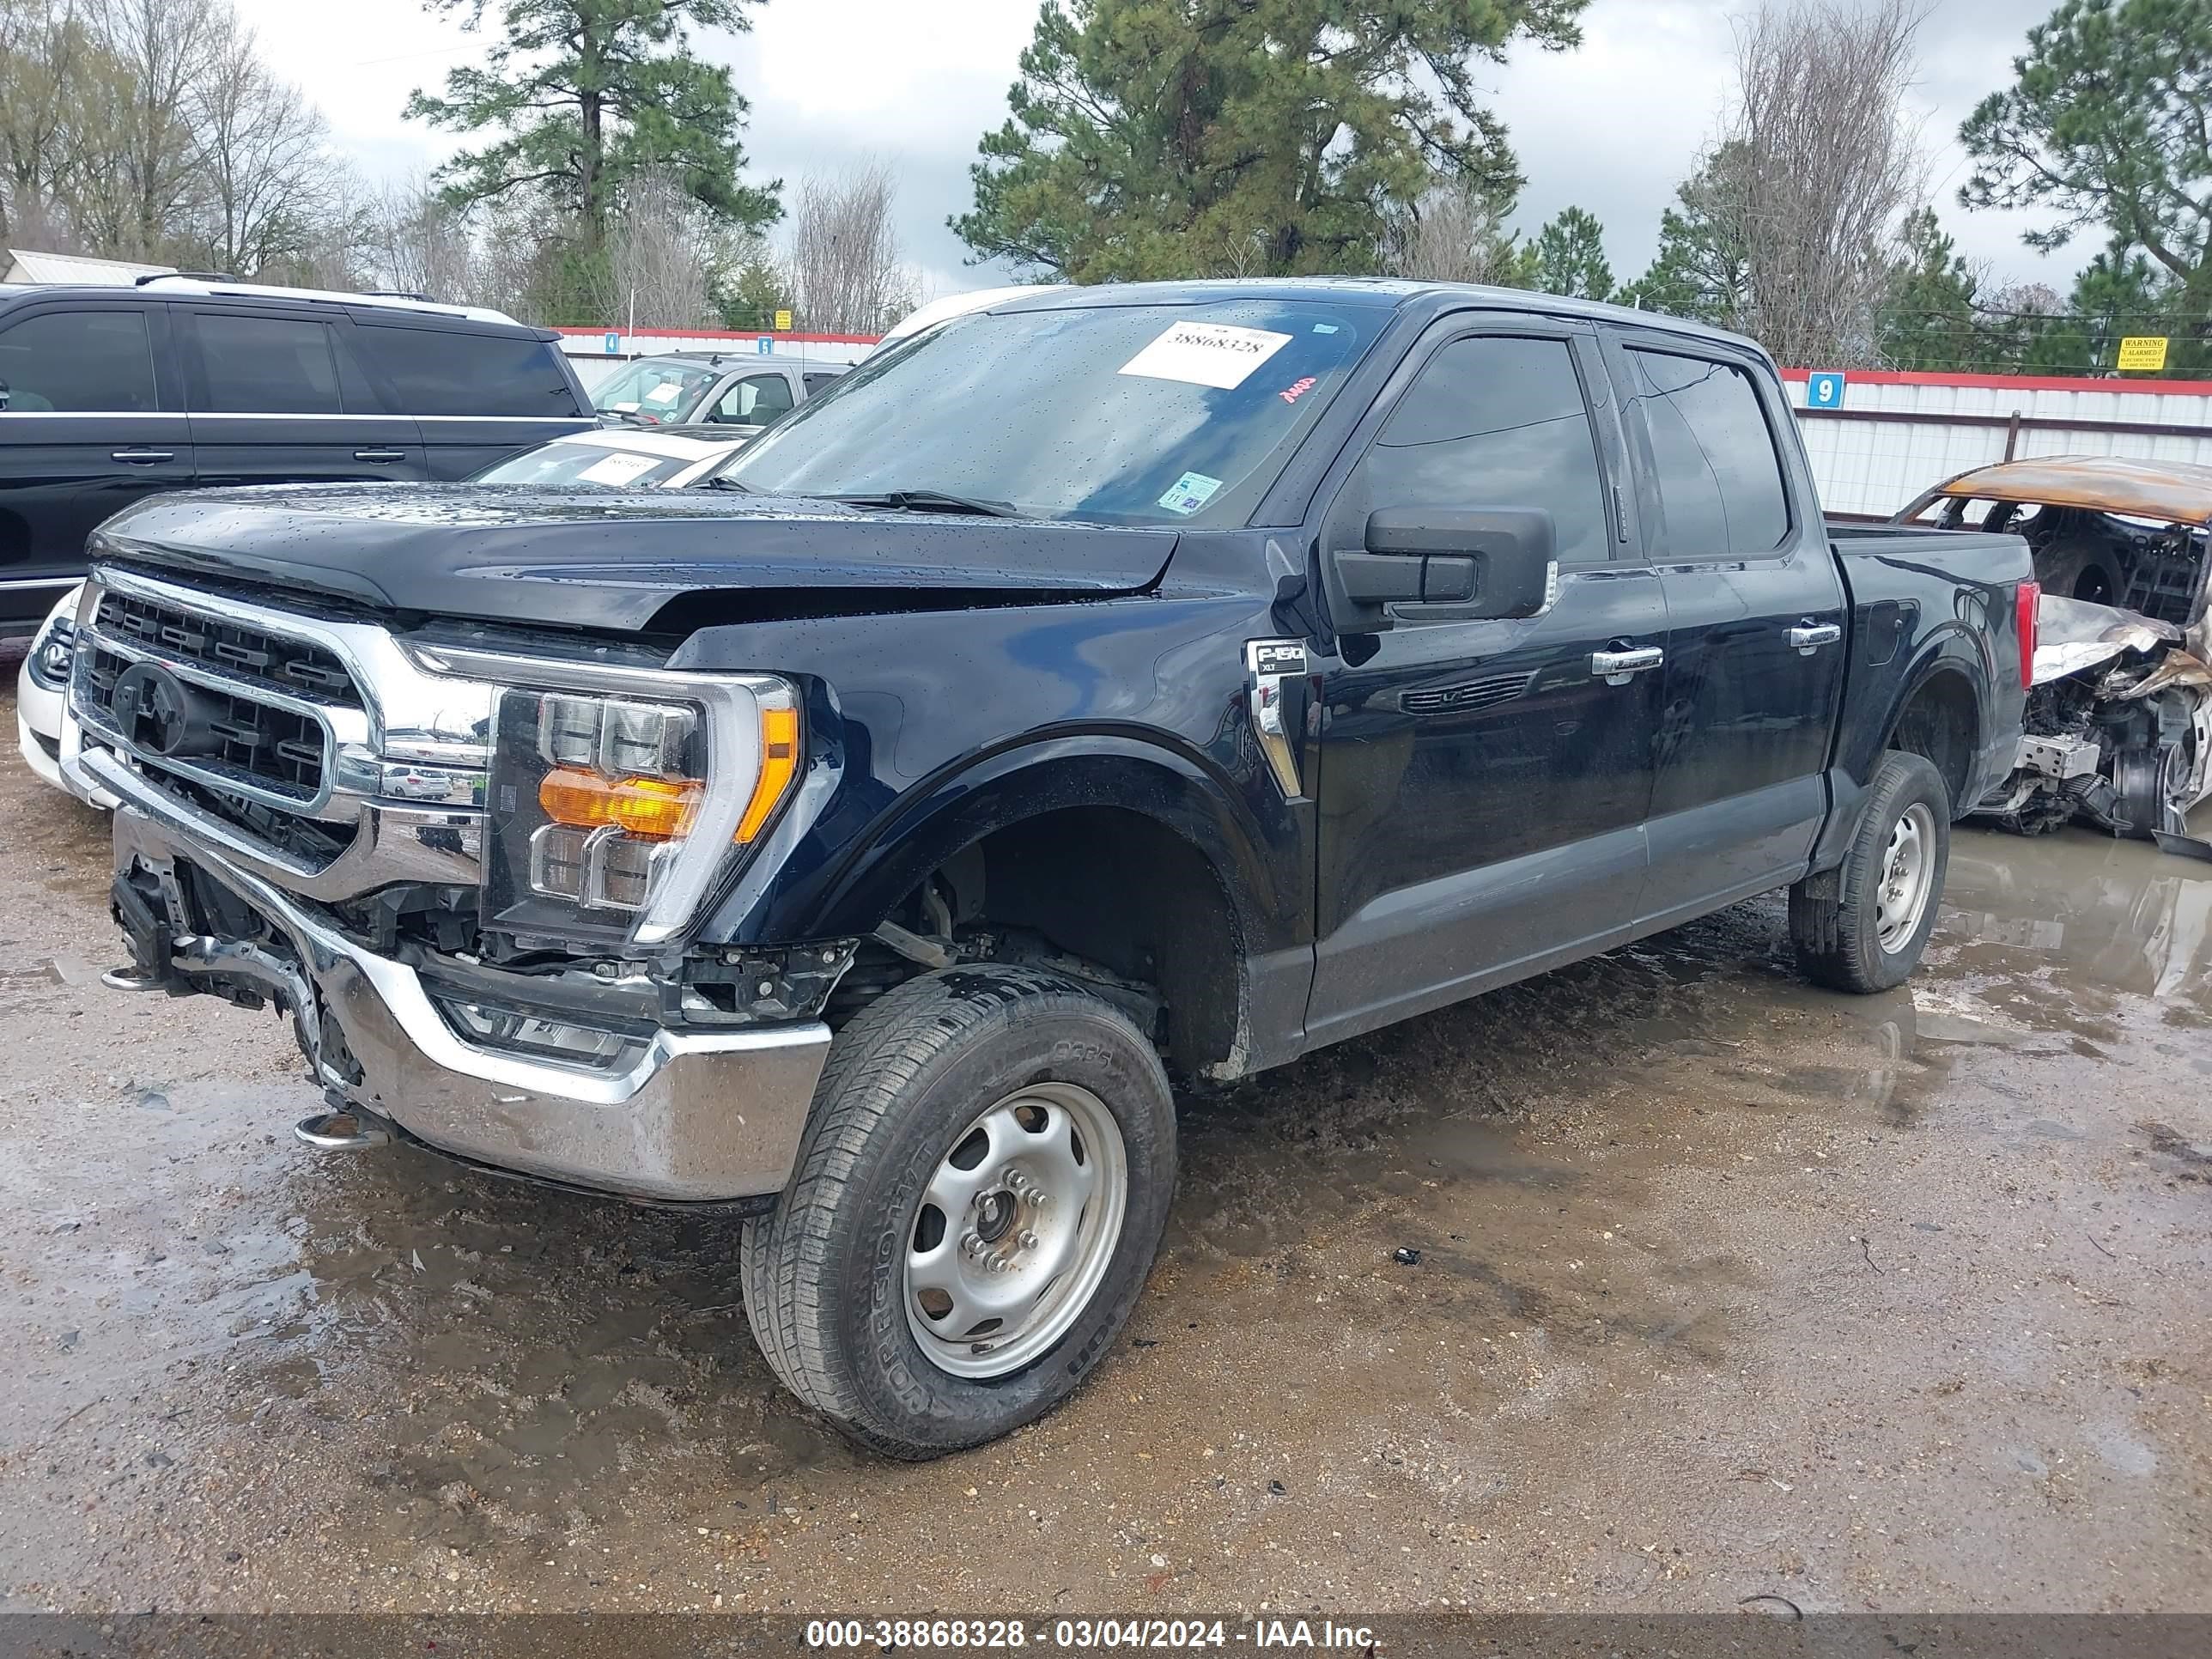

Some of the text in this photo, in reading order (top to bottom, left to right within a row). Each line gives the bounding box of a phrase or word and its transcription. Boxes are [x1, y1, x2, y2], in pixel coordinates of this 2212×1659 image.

[608, 336, 615, 350] 4
[762, 341, 769, 355] 5
[1168, 333, 1265, 354] 38868328
[1819, 379, 1833, 402] 9
[1182, 498, 1200, 508] 23
[1258, 647, 1304, 662] F-150
[1262, 664, 1276, 672] XLT
